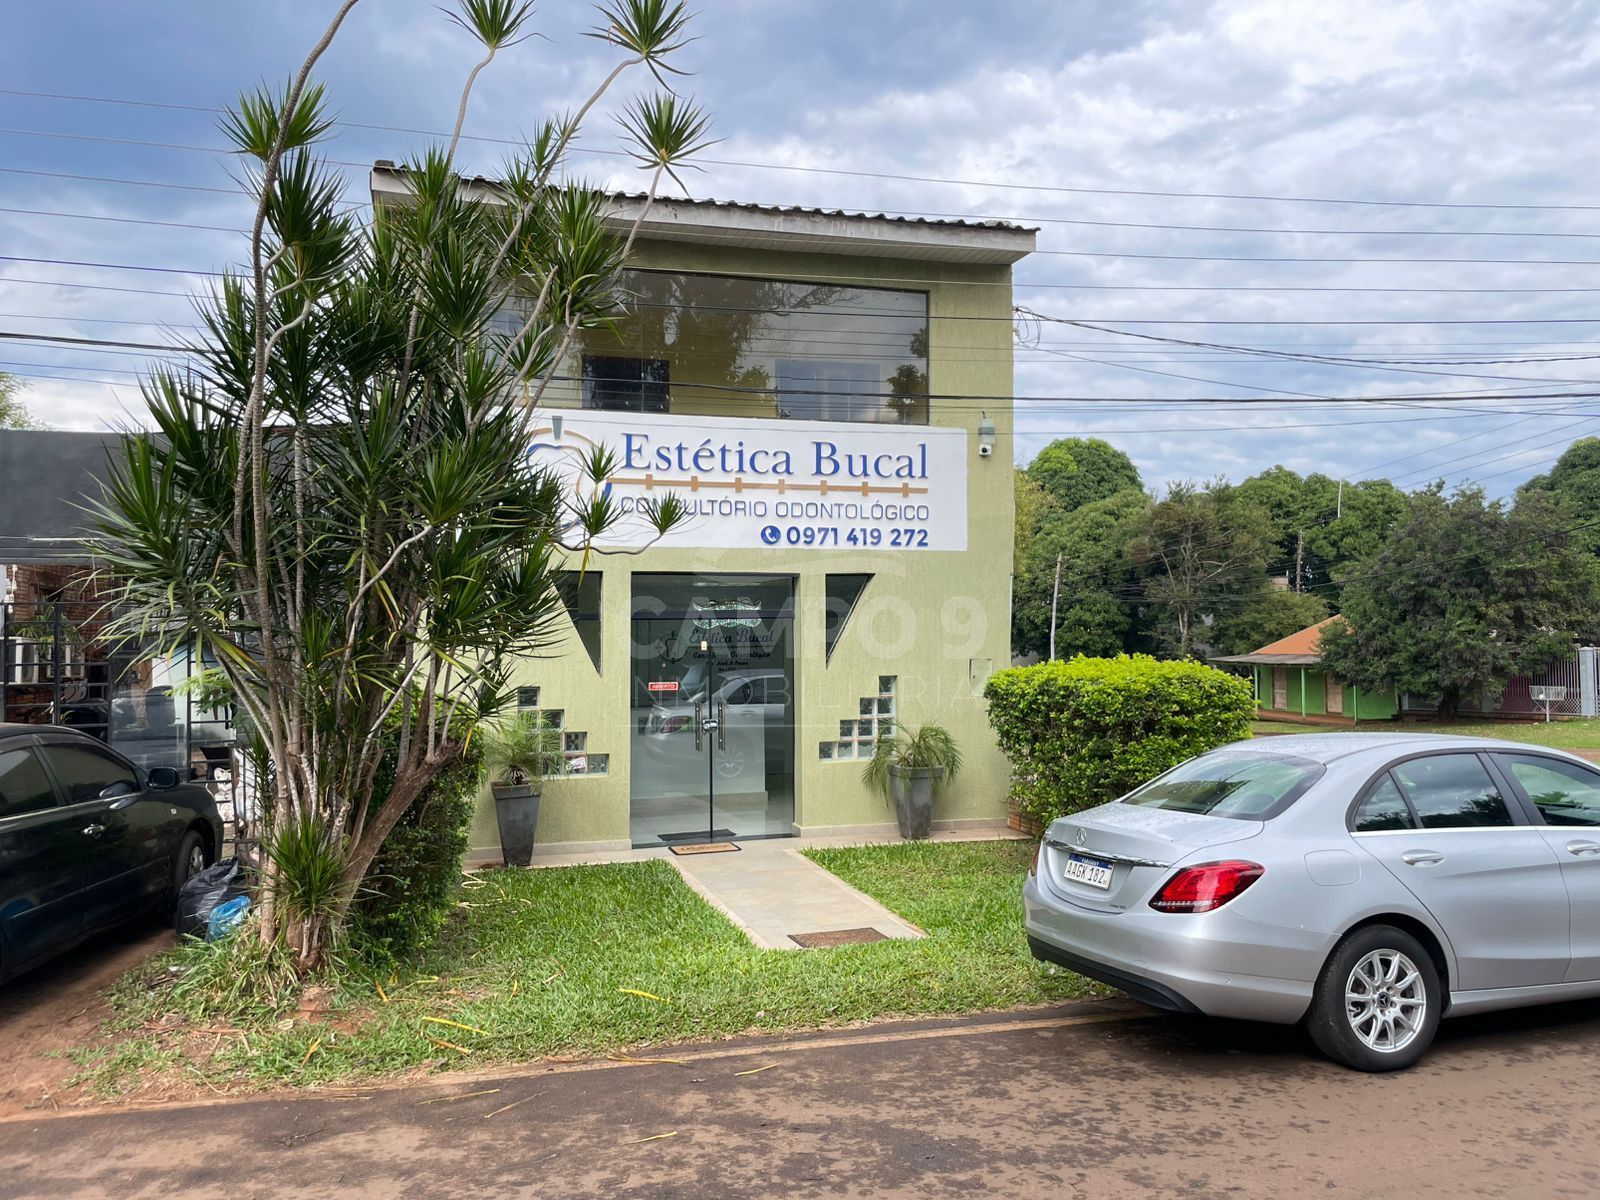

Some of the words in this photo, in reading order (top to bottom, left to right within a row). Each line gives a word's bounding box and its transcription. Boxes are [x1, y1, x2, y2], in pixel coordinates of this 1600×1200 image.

[621, 433, 794, 475] Estética
[811, 441, 928, 479] Bucal
[775, 501, 929, 521] ODONTOLÓGICO
[786, 526, 839, 545] 0971
[846, 528, 882, 546] 419
[889, 528, 929, 547] 272
[1066, 862, 1088, 879] AAGK
[1088, 867, 1105, 883] 182
